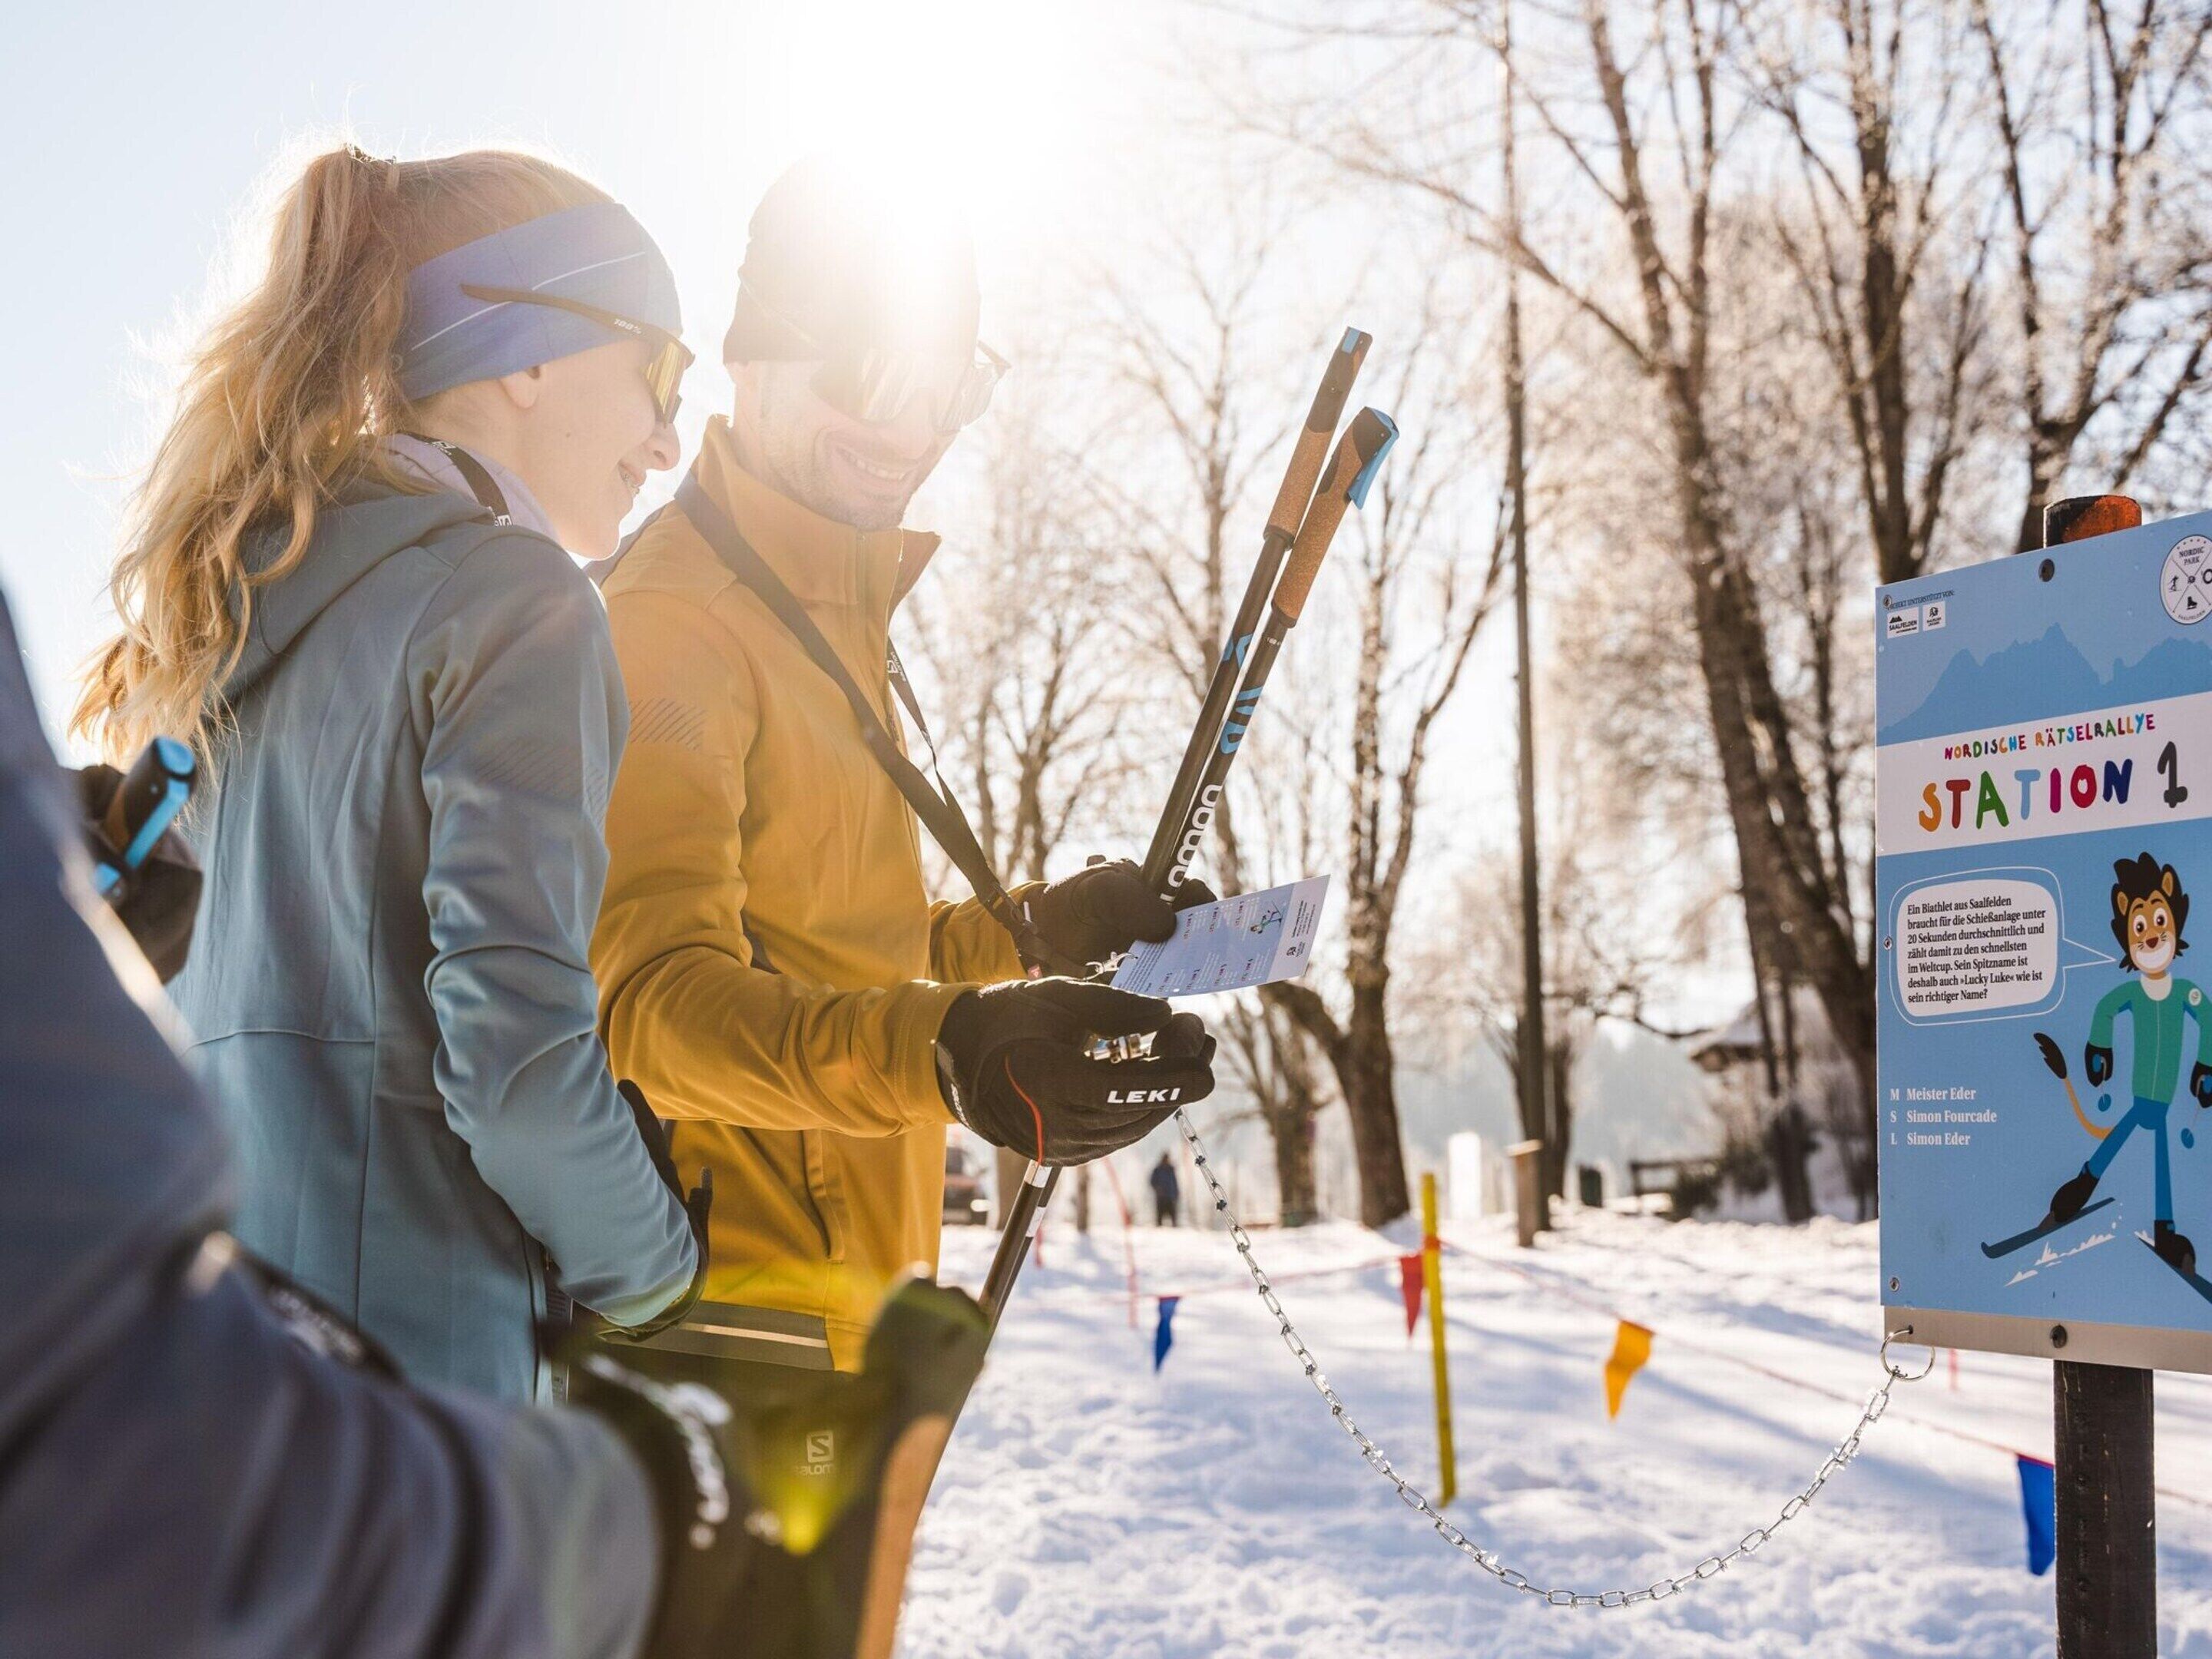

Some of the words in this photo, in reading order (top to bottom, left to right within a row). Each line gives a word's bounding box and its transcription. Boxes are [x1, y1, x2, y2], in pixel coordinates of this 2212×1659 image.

[2179, 546, 2205, 558] NORDIC
[2184, 556, 2200, 565] PARK
[1889, 619, 1917, 631] SAALFELDEN
[1944, 734, 2027, 760] NORDISCHE
[2035, 713, 2156, 747] RÄTSELRALLYE
[1919, 758, 2133, 832] STATION
[2157, 741, 2188, 809] 1
[1907, 904, 1921, 915] Ein
[1922, 901, 1953, 914] Biathlet
[1954, 901, 1969, 910] aus
[1969, 895, 2012, 909] Saalfelden
[1907, 916, 1939, 930] braucht
[1939, 916, 1952, 926] für
[1952, 914, 1965, 926] die
[1966, 909, 2022, 924] Schießanlage
[2022, 909, 2046, 920] unter
[1908, 934, 1918, 945] 20
[1918, 930, 1958, 944] Sekunden
[1959, 925, 2026, 941] durchschnittlich
[2028, 922, 2045, 935] und
[1907, 946, 1927, 959] zählt
[1928, 945, 1952, 958] damit
[1952, 946, 1963, 955] zu
[1964, 943, 1980, 955] den
[1980, 940, 2028, 954] schnellsten
[1908, 963, 1919, 973] im
[1919, 961, 1953, 974] Weltcup.
[1954, 959, 1972, 971] Sein
[1972, 957, 2017, 972] Spitzname
[2018, 955, 2028, 966] ist
[1907, 975, 1939, 988] deshalb
[1939, 975, 1959, 986] auch
[1960, 972, 1989, 987] »Lucky
[1990, 972, 2014, 984] Luke«
[2015, 970, 2032, 982] wie
[2032, 969, 2043, 981] ist
[1908, 992, 1924, 1003] sein
[1925, 990, 1959, 1004] richtiger
[1960, 988, 1988, 1000] Name?
[1107, 1088, 1181, 1104] LEKI
[1890, 1088, 1899, 1101] M
[1906, 1087, 1949, 1101] Meister
[1949, 1086, 1977, 1100] Eder
[1890, 1110, 1897, 1123] S
[1906, 1109, 1942, 1123] Simon
[1944, 1109, 1998, 1123] Fourcade
[1890, 1132, 1898, 1145] L
[1906, 1131, 1942, 1146] Simon
[1944, 1131, 1971, 1146] Eder
